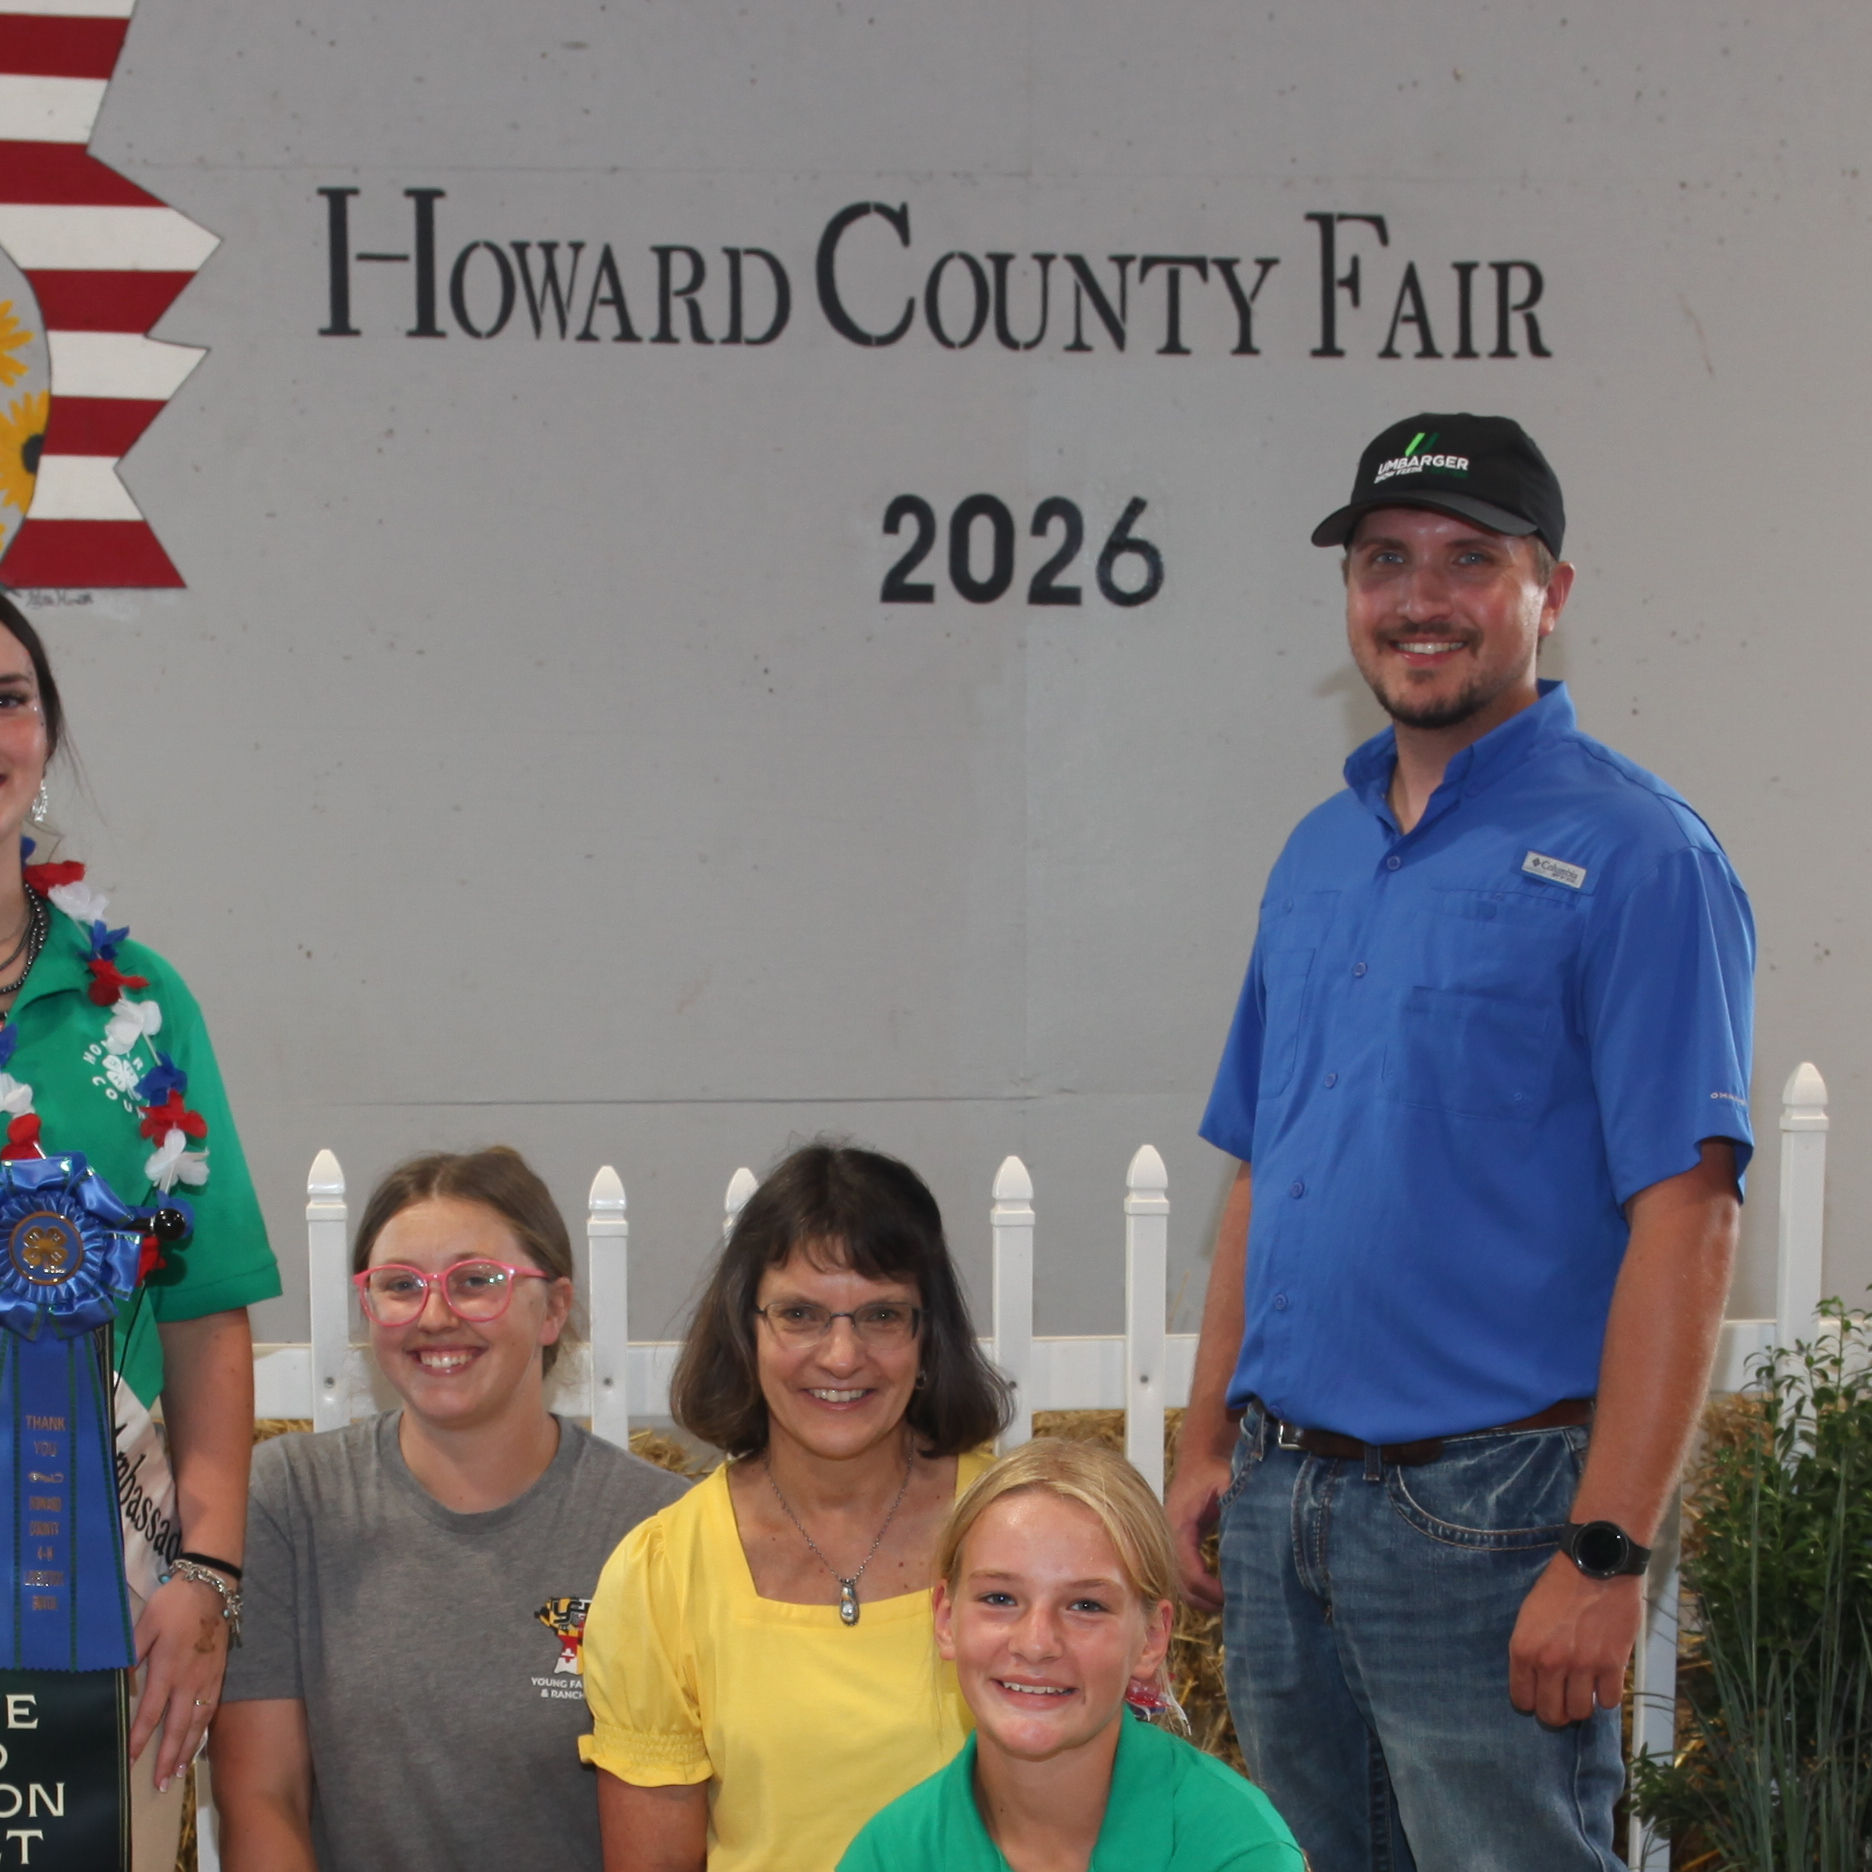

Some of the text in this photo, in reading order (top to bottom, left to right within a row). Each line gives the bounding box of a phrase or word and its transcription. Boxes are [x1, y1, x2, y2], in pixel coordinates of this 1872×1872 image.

[1377, 454, 1470, 475] UMBARGER
[880, 493, 1165, 607] 2026
[25, 1415, 66, 1432] THANK
[33, 1440, 58, 1457] YOU
[531, 1677, 568, 1689] YOUNG
